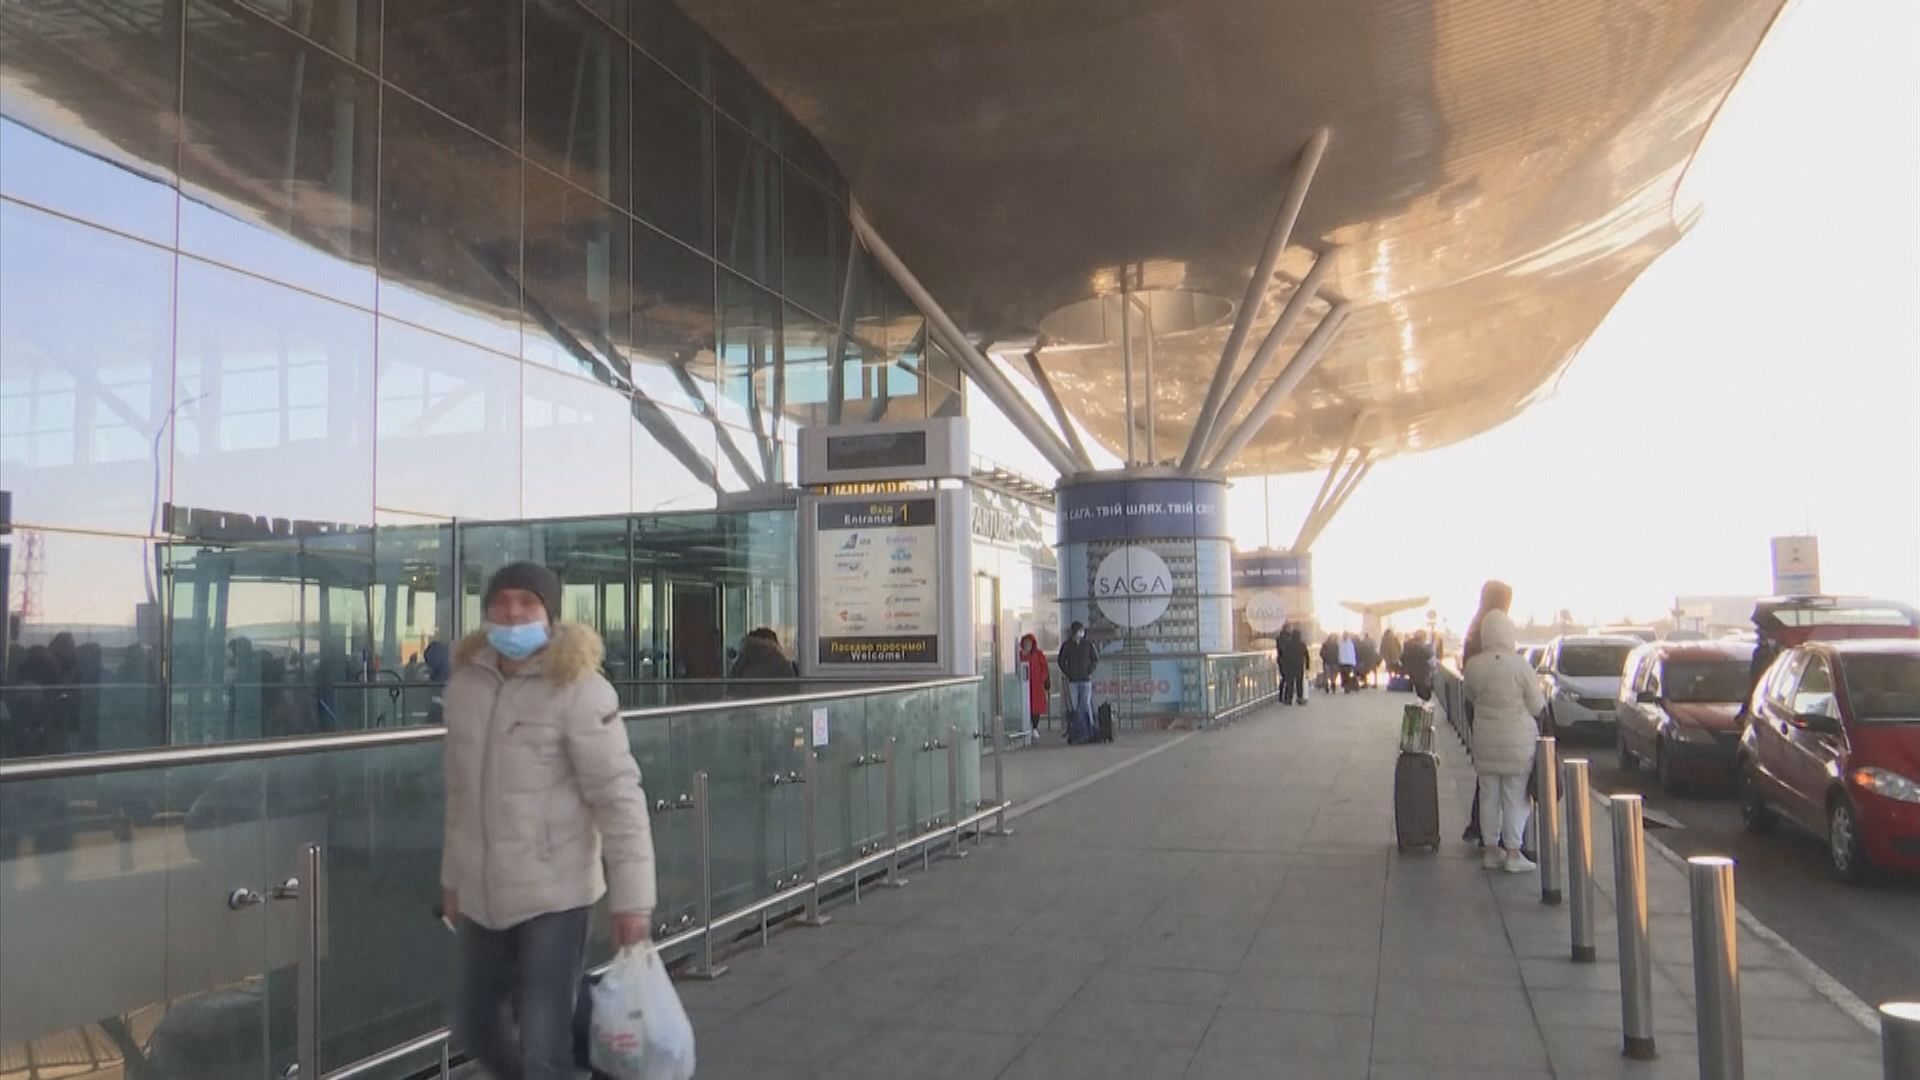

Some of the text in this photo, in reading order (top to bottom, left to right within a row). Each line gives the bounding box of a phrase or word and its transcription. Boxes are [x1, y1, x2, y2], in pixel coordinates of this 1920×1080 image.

[901, 502, 908, 522] 1
[1096, 503, 1123, 517] ТВІЙ
[1126, 503, 1166, 516] ШЛЯХ.
[1167, 502, 1193, 514] ТВІЙ
[844, 513, 894, 526] Entrance
[1100, 576, 1167, 595] SAGA
[876, 640, 926, 653] просимо!
[851, 650, 905, 661] Welcome!
